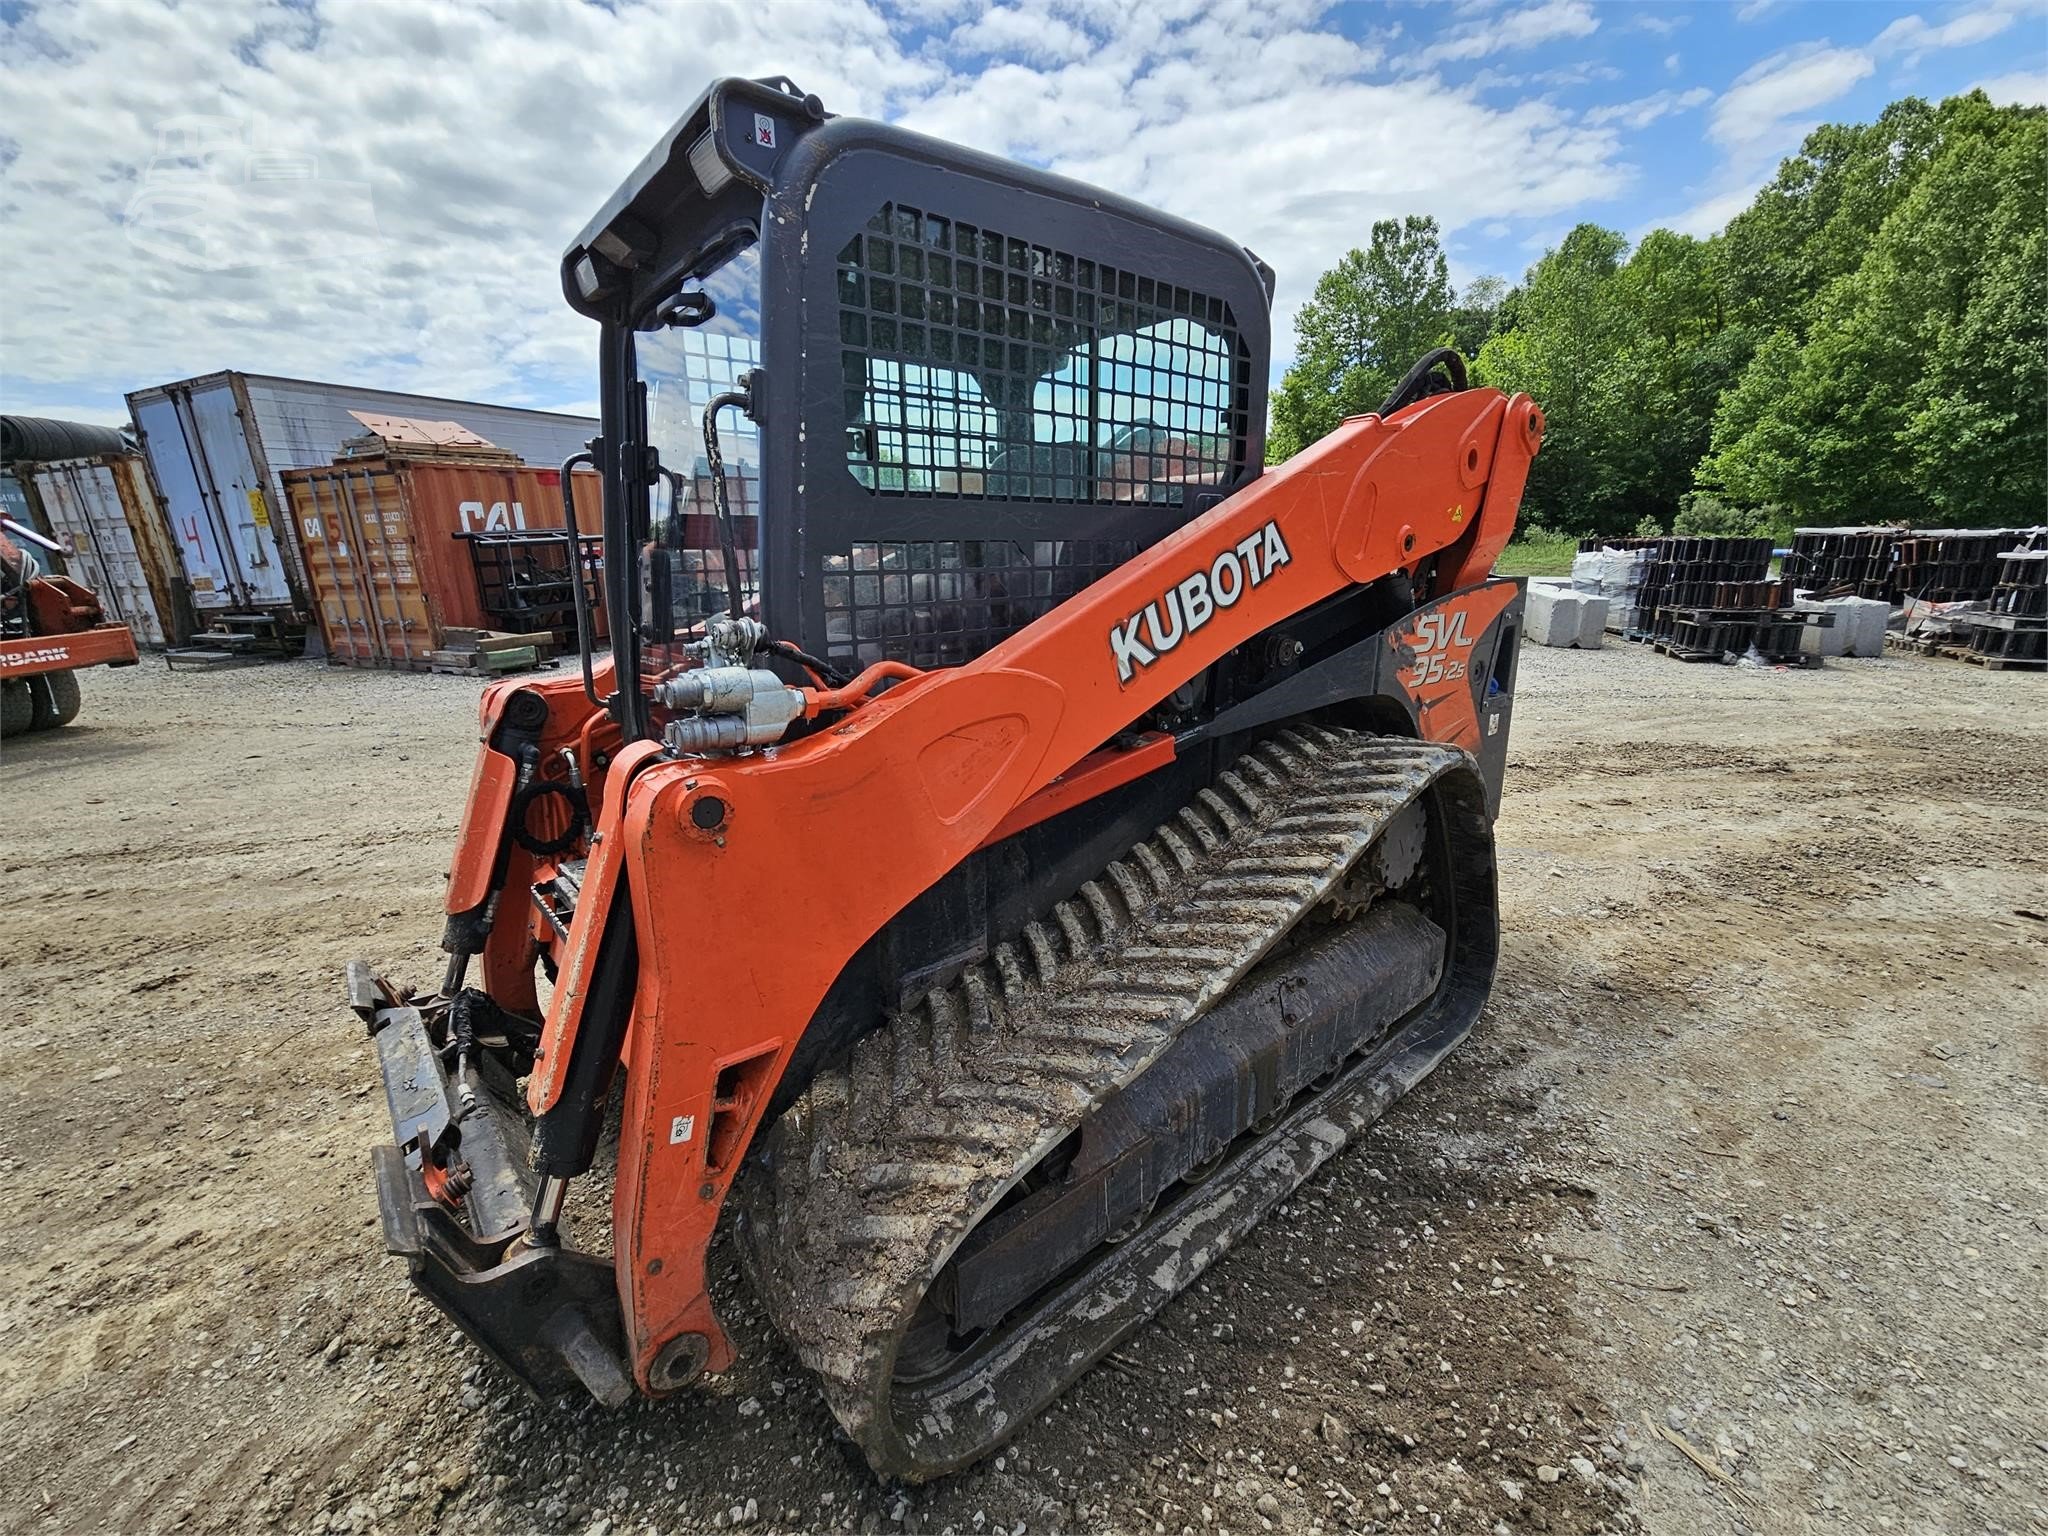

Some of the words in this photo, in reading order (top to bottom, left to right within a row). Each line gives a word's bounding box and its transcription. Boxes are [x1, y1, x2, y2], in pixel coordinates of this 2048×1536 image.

[181, 515, 205, 564] 4
[1110, 521, 1291, 683] KUBOTA
[1412, 611, 1473, 654] SVL
